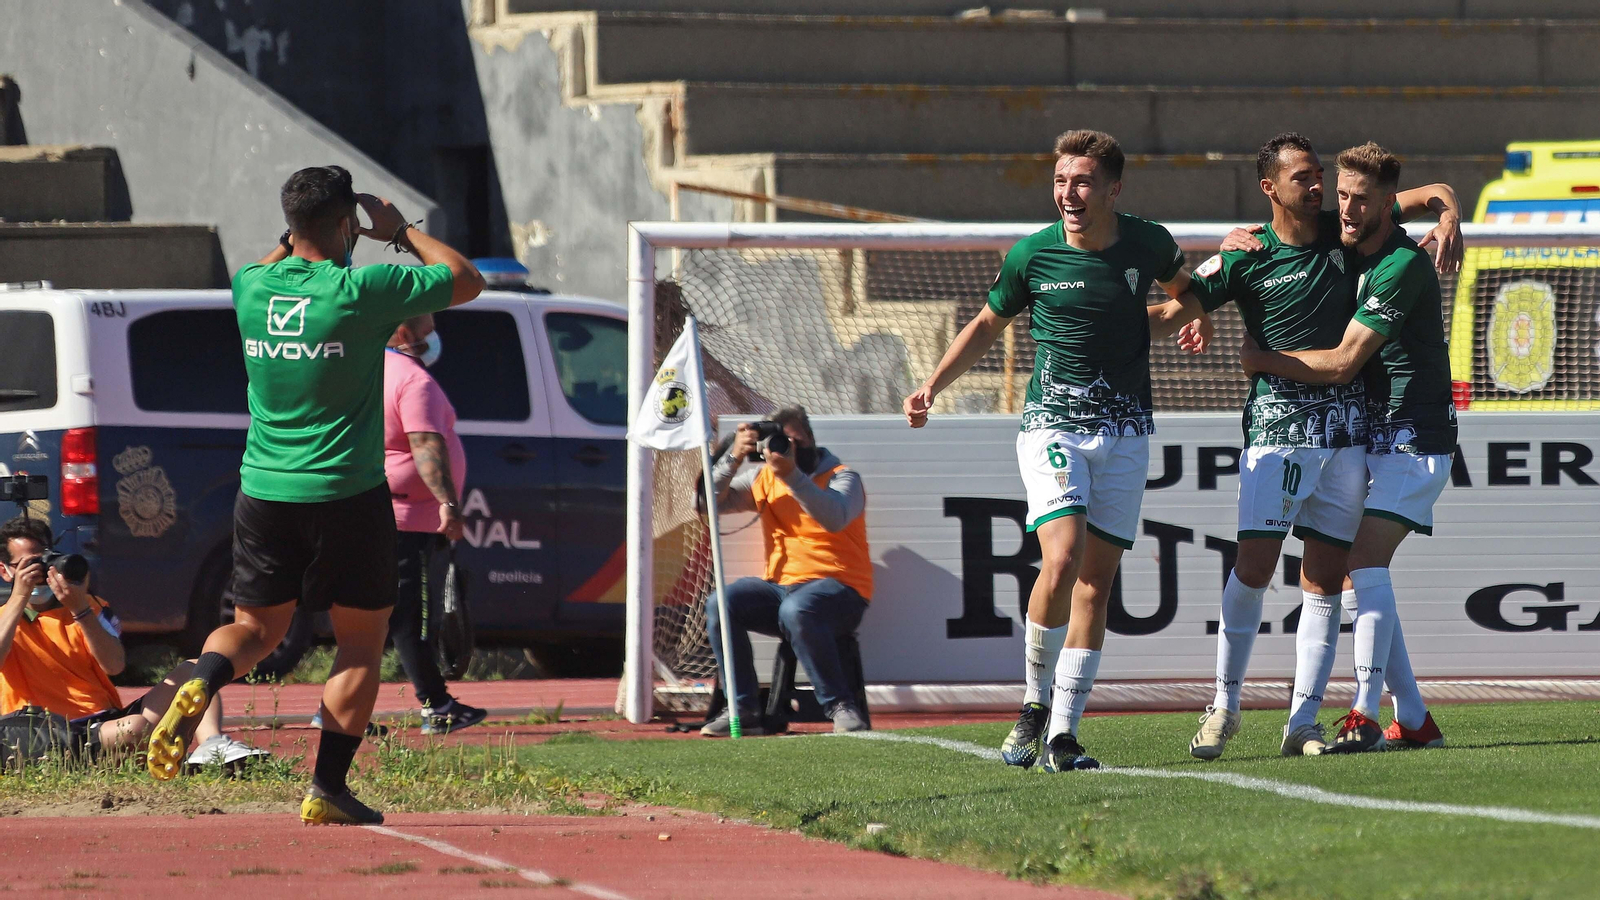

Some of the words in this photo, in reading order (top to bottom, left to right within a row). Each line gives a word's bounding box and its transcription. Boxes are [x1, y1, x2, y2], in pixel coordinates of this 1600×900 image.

[1040, 281, 1085, 291] GIVOVA
[1263, 271, 1308, 288] GIVOVA
[90, 301, 127, 317] 4BJ
[245, 339, 344, 360] GIVOVA
[1047, 442, 1068, 469] 6
[1282, 459, 1302, 496] 10
[1046, 495, 1083, 507] GIVOVA
[1464, 582, 1600, 633] G
